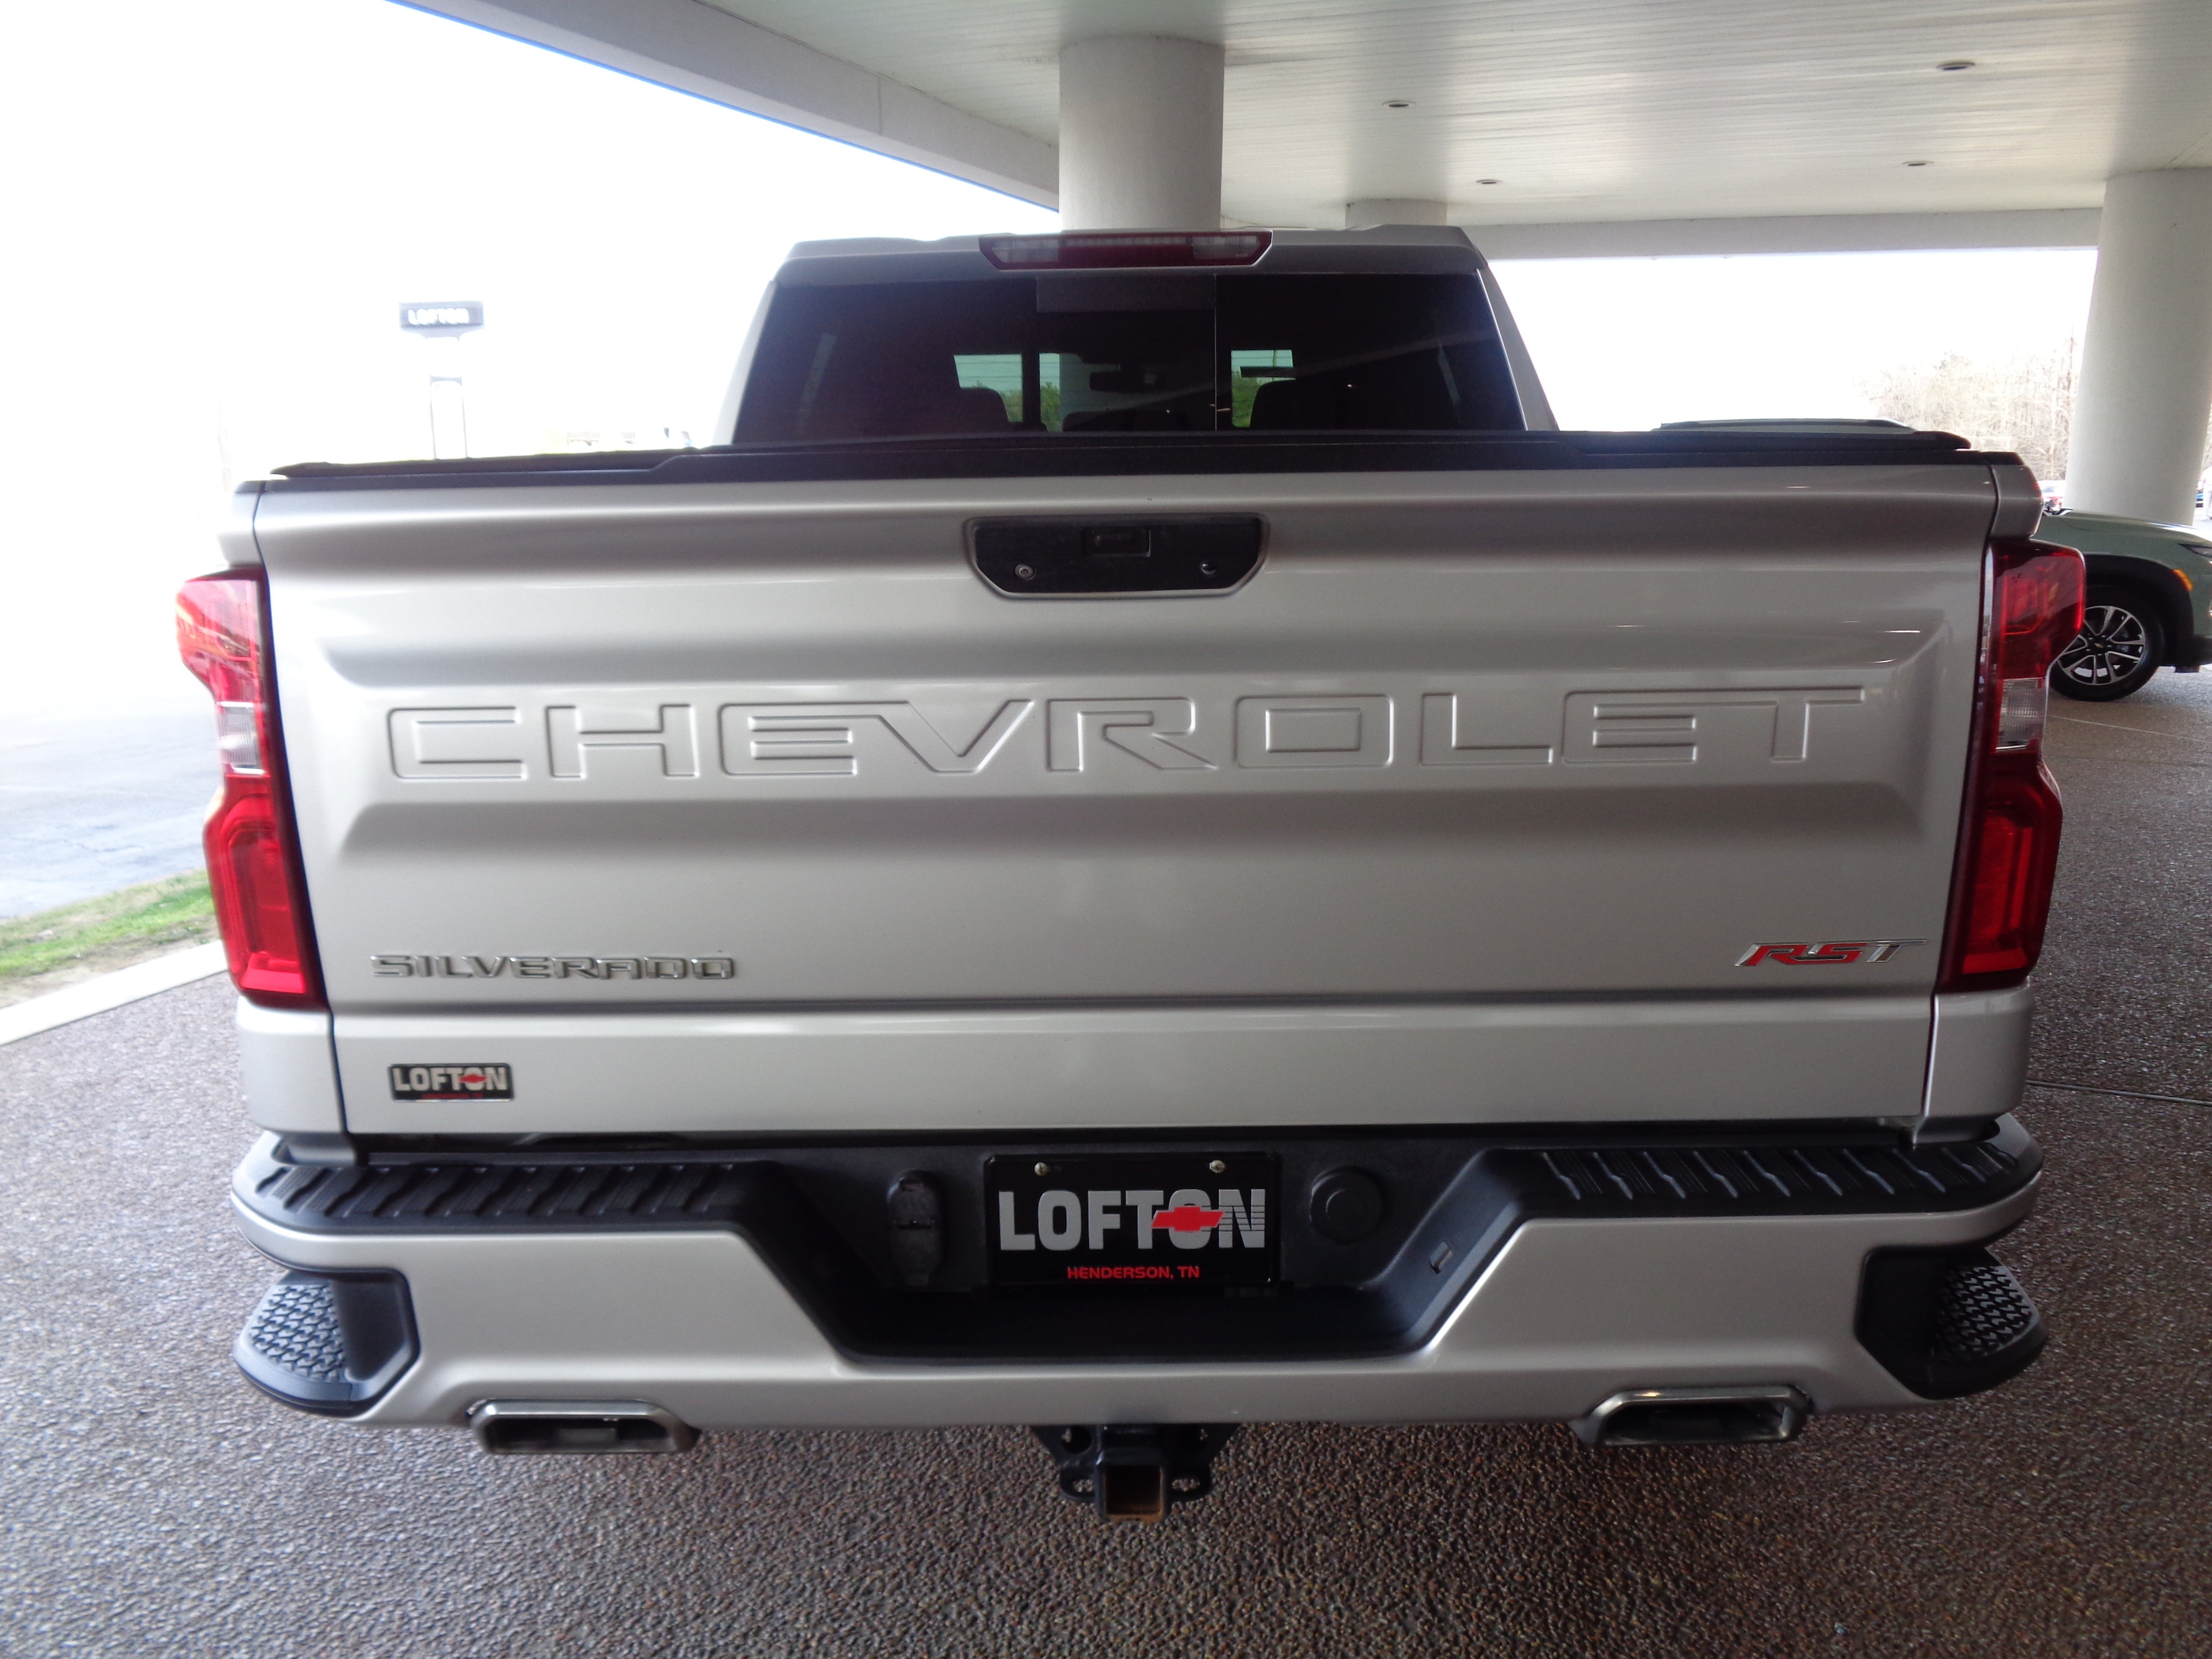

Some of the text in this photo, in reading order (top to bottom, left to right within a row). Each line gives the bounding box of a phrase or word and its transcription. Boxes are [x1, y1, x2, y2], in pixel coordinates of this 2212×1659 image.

[386, 685, 1866, 782] CHEVROLET
[1734, 938, 1927, 966] RST
[371, 955, 735, 980] SILVERADO
[392, 1067, 508, 1091] LOFTON
[999, 1189, 1265, 1250] LOFTON
[1067, 1266, 1200, 1280] HENDERSON, TN
